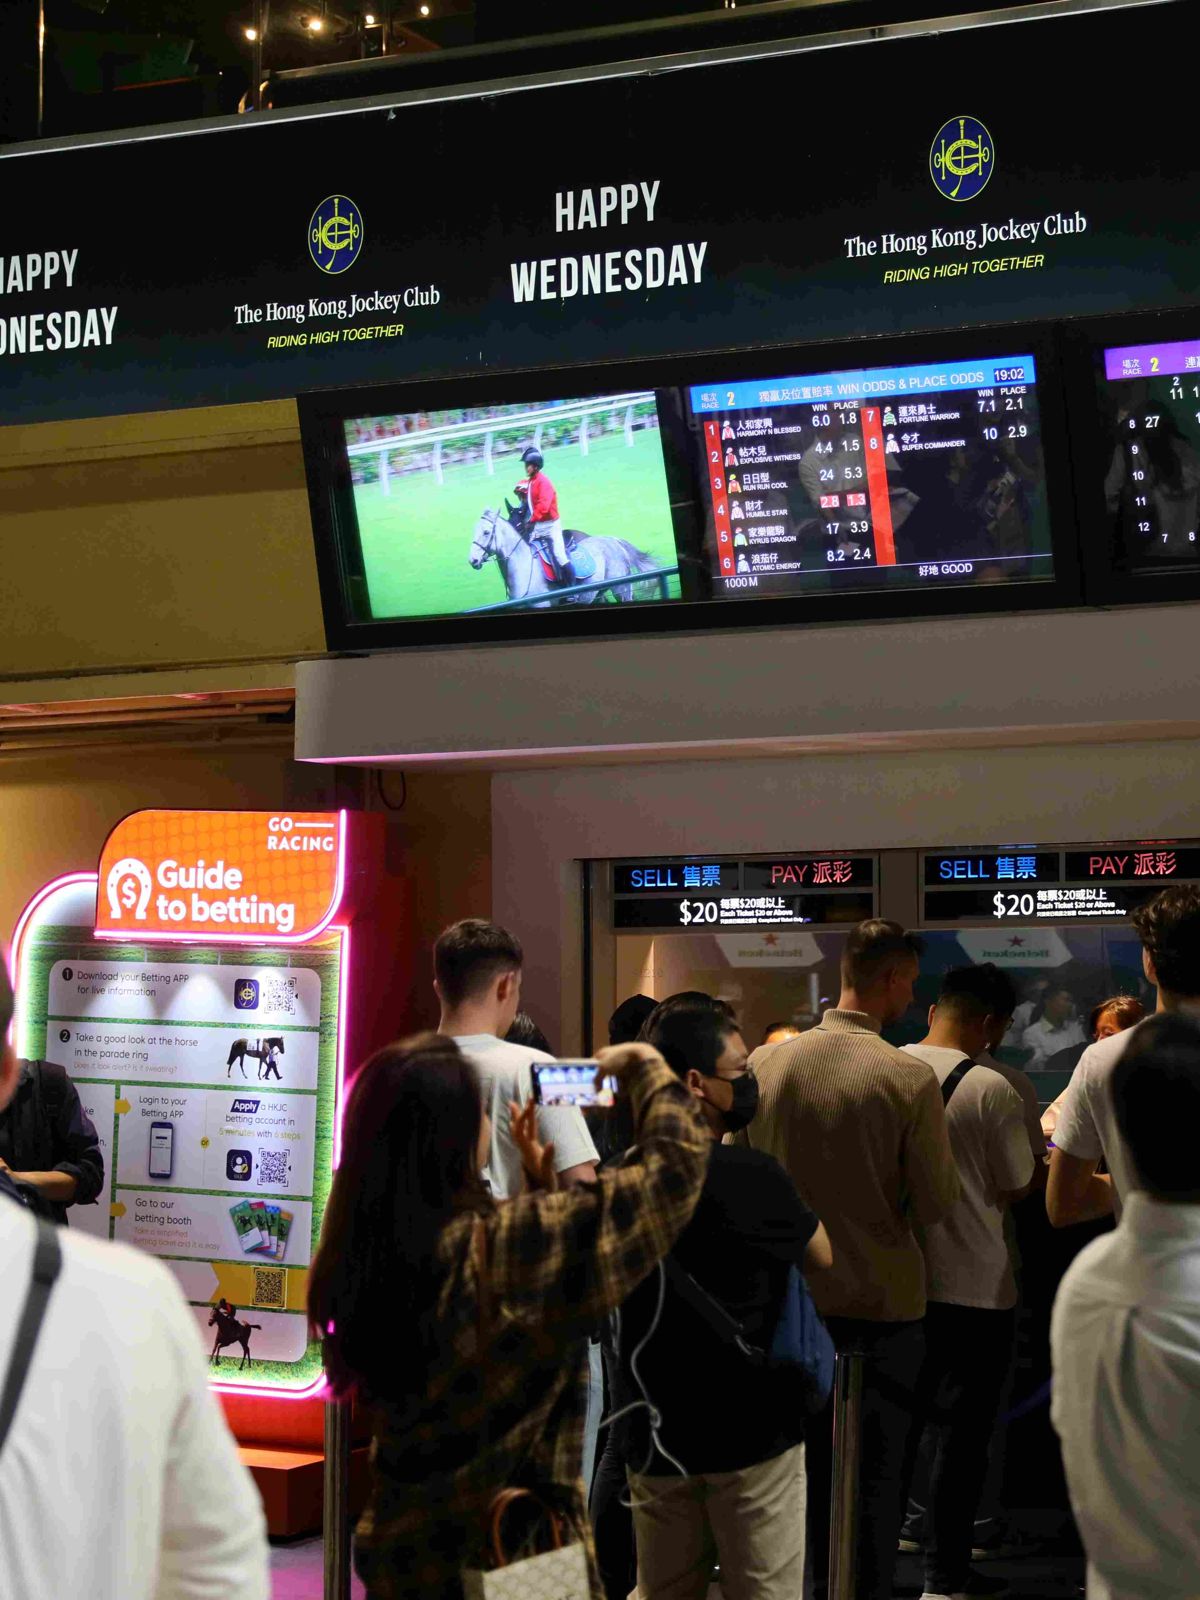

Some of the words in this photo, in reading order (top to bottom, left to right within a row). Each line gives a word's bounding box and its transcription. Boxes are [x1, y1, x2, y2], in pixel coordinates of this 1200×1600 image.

[556, 180, 660, 232] HAPPY
[844, 236, 876, 258] The
[881, 234, 927, 255] Hong
[931, 228, 976, 250] Kong
[979, 218, 1040, 248] Jockey
[1044, 211, 1087, 235] Club
[511, 242, 707, 303] WEDNESDAY
[884, 267, 930, 283] RIDING
[933, 263, 969, 278] HIGH
[972, 255, 1044, 274] TOGETHER
[234, 304, 262, 324] The
[266, 303, 305, 323] Hong
[309, 299, 346, 320] Kong
[349, 291, 401, 317] Jockey
[404, 285, 440, 308] Club
[267, 334, 307, 348] RIDING
[310, 331, 340, 344] HIGH
[342, 324, 403, 340] TOGETHER
[837, 383, 859, 394] WIN
[863, 380, 895, 392] ODDS
[899, 378, 906, 389] &
[910, 375, 946, 388] PLACE
[950, 371, 984, 385] ODDS
[994, 368, 1024, 381] 19:02
[978, 400, 995, 413] 7.1
[1005, 398, 1023, 411] 2.1
[812, 414, 830, 427] 6.0
[840, 413, 856, 425] 1.8
[983, 428, 998, 440] 10
[1008, 426, 1026, 438] 2.9
[919, 564, 939, 577] 好地
[941, 563, 972, 574] GOOD
[269, 818, 293, 832] GO
[268, 836, 333, 850] RACING
[157, 860, 242, 889] Guide
[772, 865, 808, 883] PAY
[813, 861, 852, 883] 派彩
[940, 860, 989, 879] SELL
[996, 857, 1036, 880] 售票
[1089, 856, 1129, 874] PAY
[1134, 852, 1176, 875] 派彩
[631, 870, 677, 887] SELL
[682, 866, 720, 888] 售票
[156, 896, 185, 921] to
[191, 894, 294, 932] betting
[680, 900, 717, 925] $20
[993, 892, 1033, 918] $20
[77, 971, 118, 980] Download
[120, 974, 139, 983] your
[141, 973, 170, 984] Betting
[78, 986, 88, 994] for
[92, 986, 105, 994] live
[108, 987, 156, 996] information
[76, 1033, 93, 1042] Take
[104, 1034, 125, 1045] good
[128, 1035, 144, 1044] look
[148, 1036, 157, 1044] at
[160, 1036, 172, 1045] the
[175, 1037, 198, 1046] horse
[84, 1049, 97, 1057] the
[100, 1050, 129, 1059] parade
[132, 1052, 148, 1061] ring
[234, 1101, 257, 1113] Apply
[136, 1198, 147, 1207] Go
[150, 1199, 158, 1208] to
[160, 1201, 174, 1209] our
[135, 1214, 164, 1225] betting
[167, 1215, 192, 1225] booth
